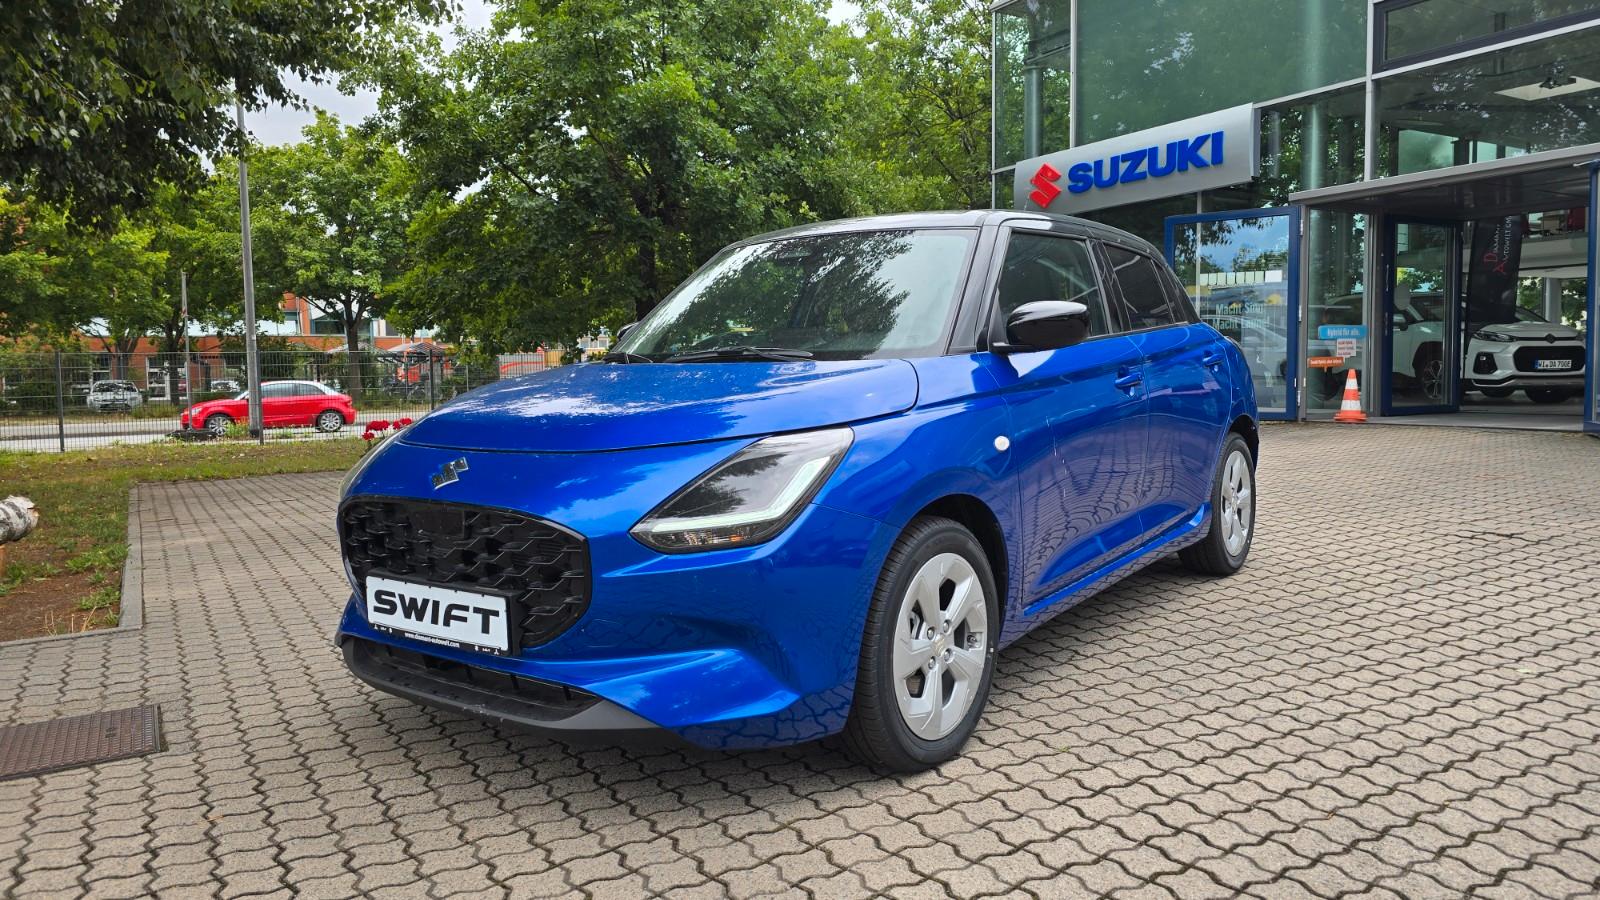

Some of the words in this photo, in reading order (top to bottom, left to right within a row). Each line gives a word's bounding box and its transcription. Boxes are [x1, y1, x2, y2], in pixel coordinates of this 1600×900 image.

[1067, 130, 1224, 194] SUZUKI
[1212, 317, 1239, 330] Macht
[1215, 302, 1242, 316] Macht
[373, 589, 500, 635] SWIFT
